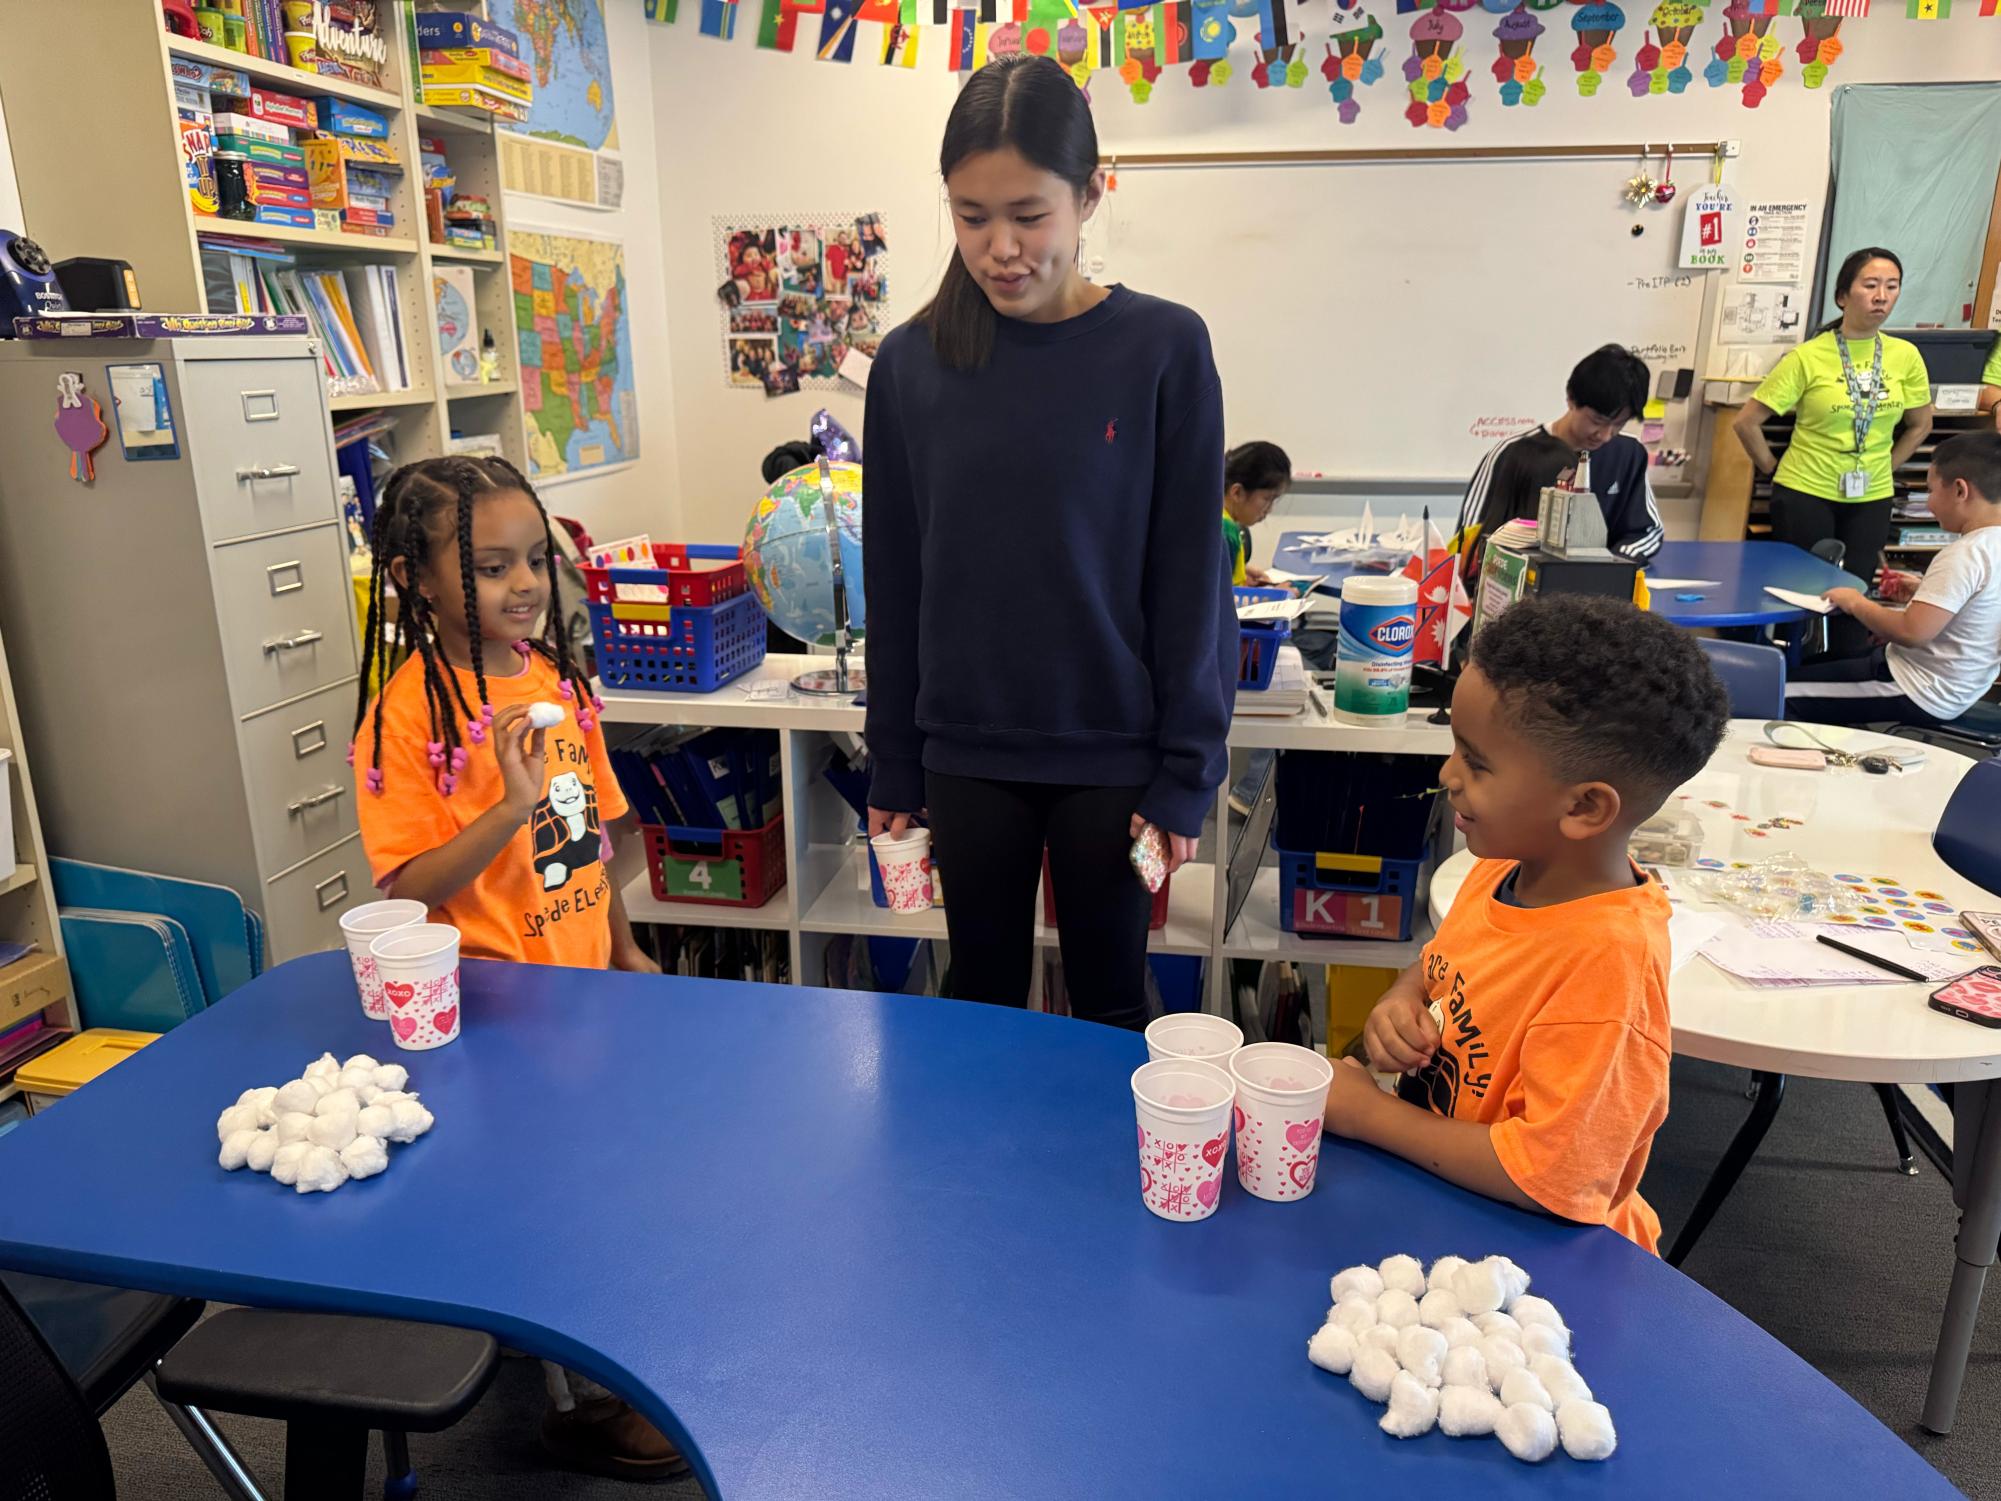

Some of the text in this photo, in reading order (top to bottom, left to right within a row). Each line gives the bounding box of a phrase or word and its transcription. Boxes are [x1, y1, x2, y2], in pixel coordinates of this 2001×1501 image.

[1427, 19, 1444, 35] July
[1504, 19, 1531, 31] August
[1577, 11, 1619, 24] September
[313, 1, 388, 64] Adventure
[181, 129, 211, 163] SNAP
[197, 155, 209, 178] IT
[1696, 203, 1732, 211] YOU'RE
[1702, 217, 1720, 240] #1
[1690, 255, 1725, 264] BOOK
[688, 861, 713, 890] 4
[1305, 890, 1384, 929] K 1
[1427, 953, 1449, 982] are
